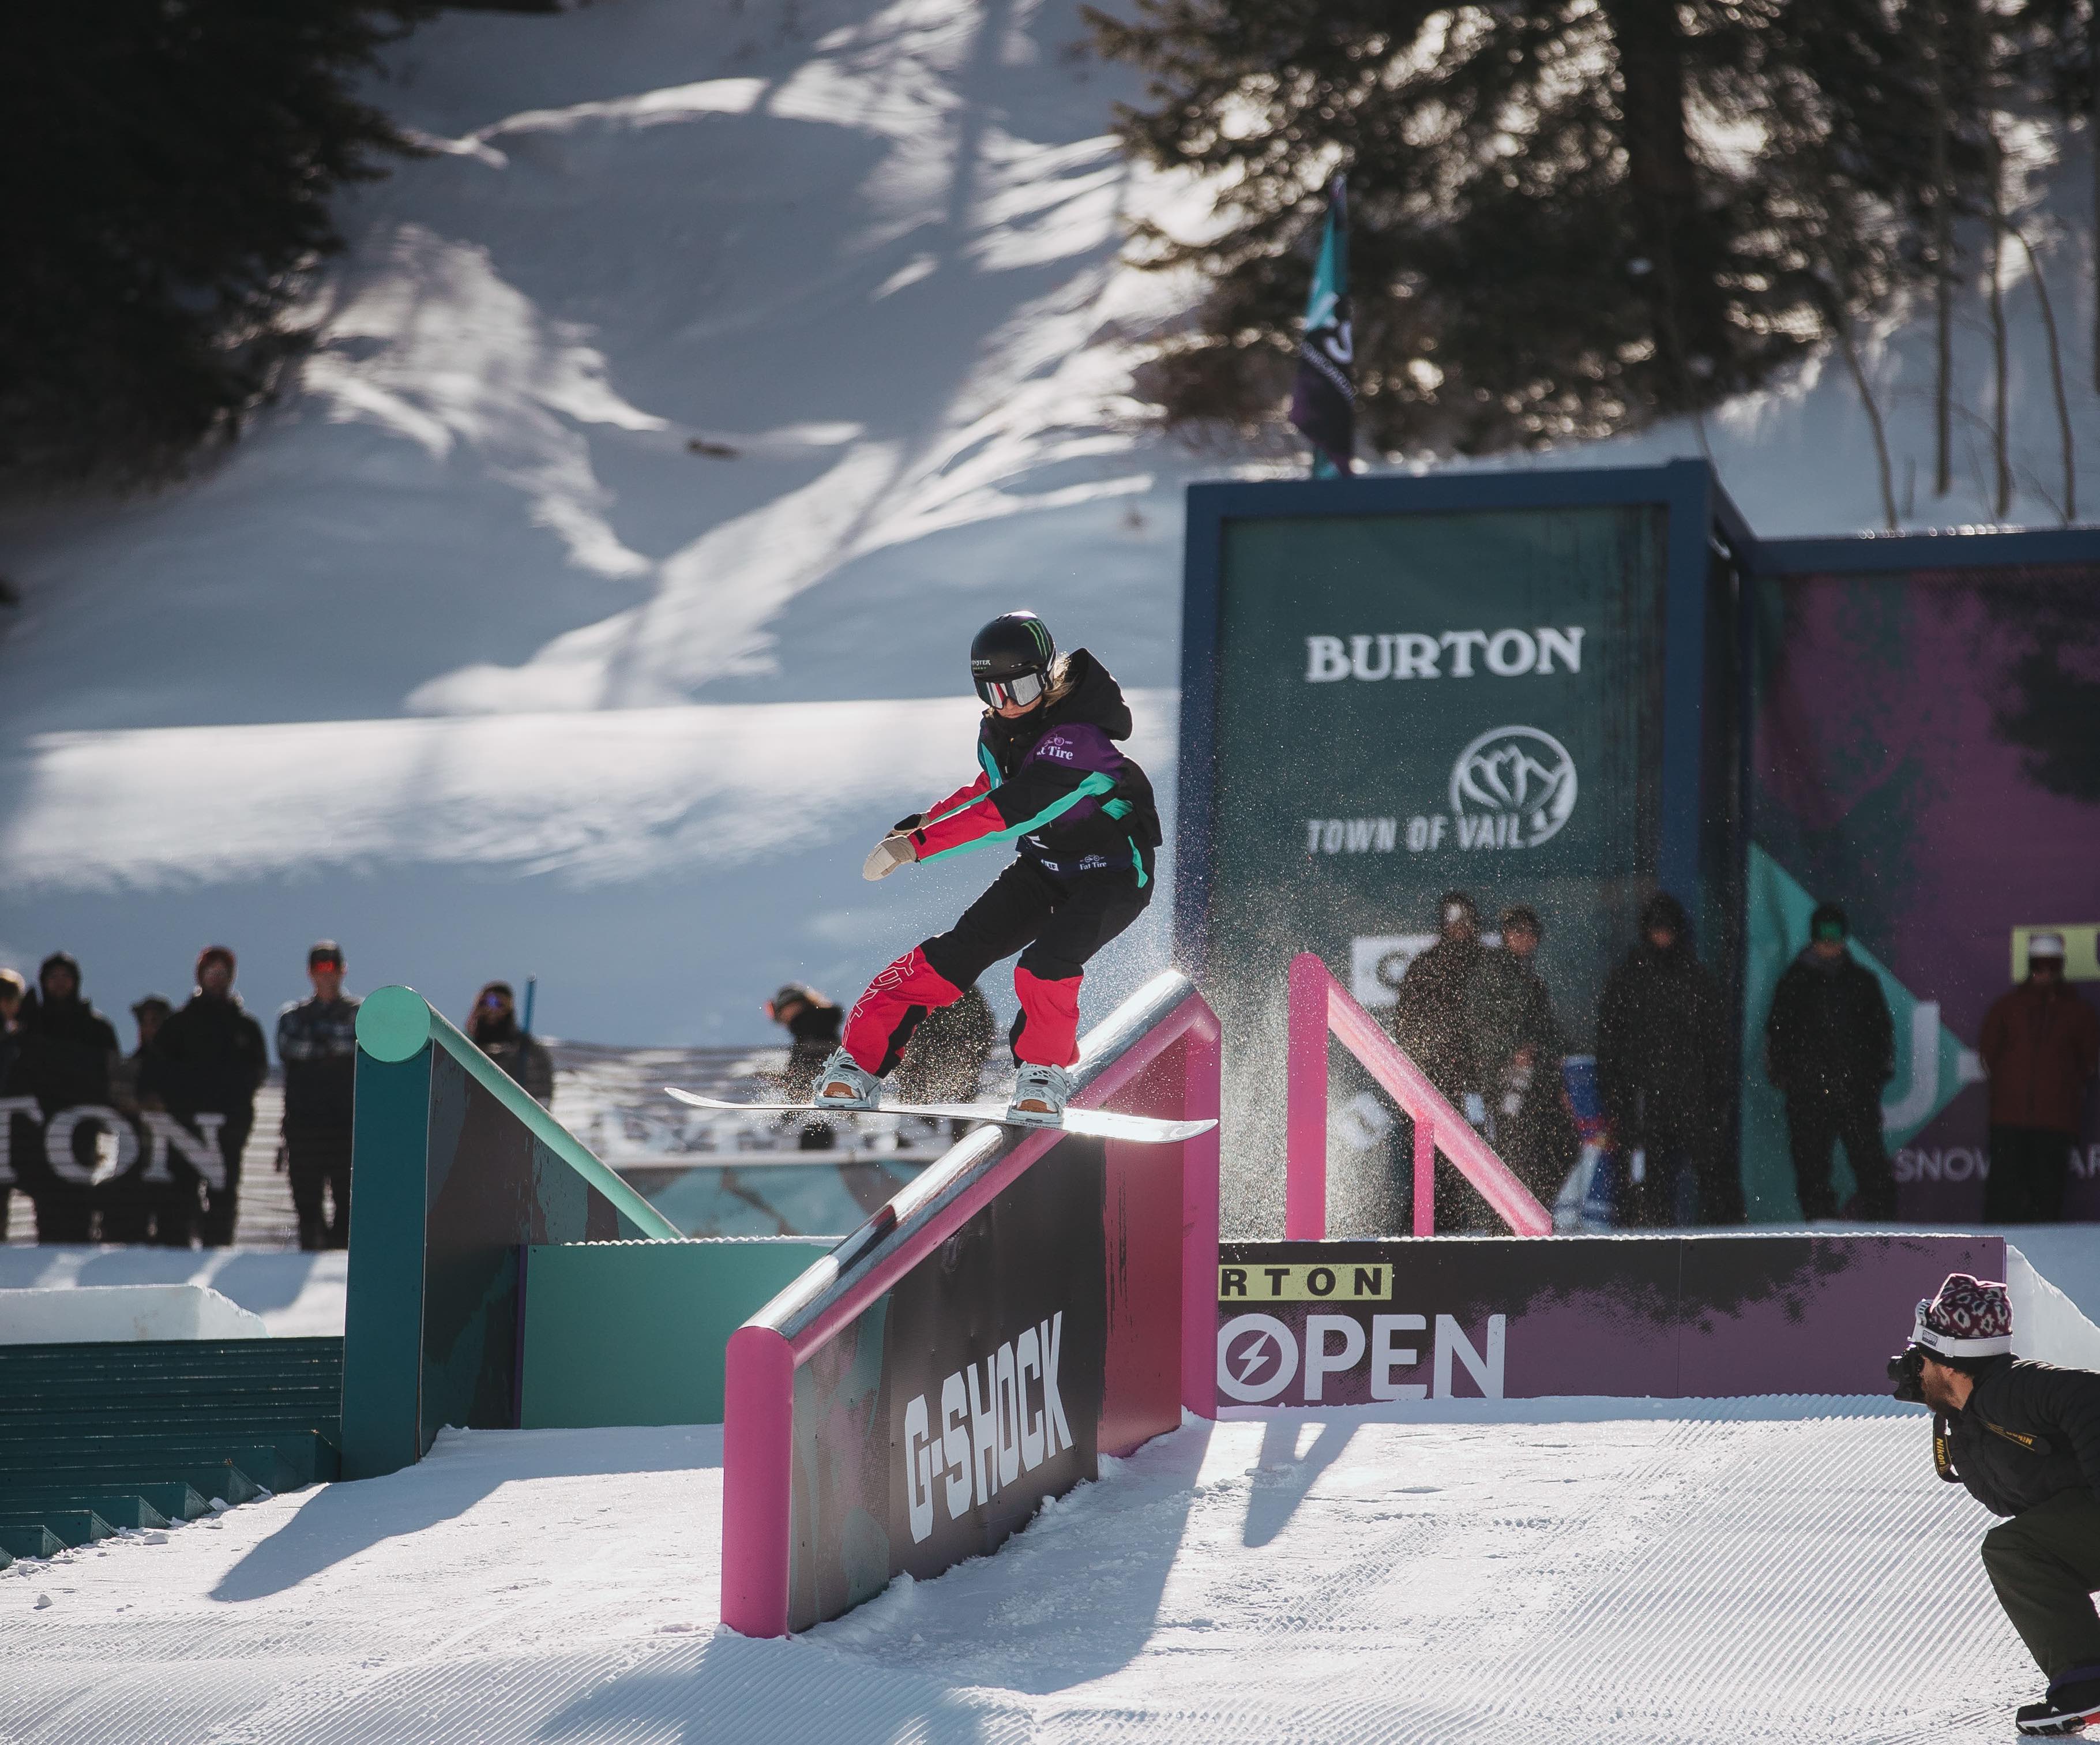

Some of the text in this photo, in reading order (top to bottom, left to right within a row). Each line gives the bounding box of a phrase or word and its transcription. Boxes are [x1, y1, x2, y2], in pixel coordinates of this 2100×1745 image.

[1305, 626, 1586, 683] BURTON
[1048, 746, 1073, 760] Tire
[1308, 812, 1527, 855] TOWN OF VAIL
[1217, 1313, 1506, 1402] OPEN
[905, 1311, 1073, 1544] G-SHOCK
[1937, 1438, 1946, 1465] Nikon
